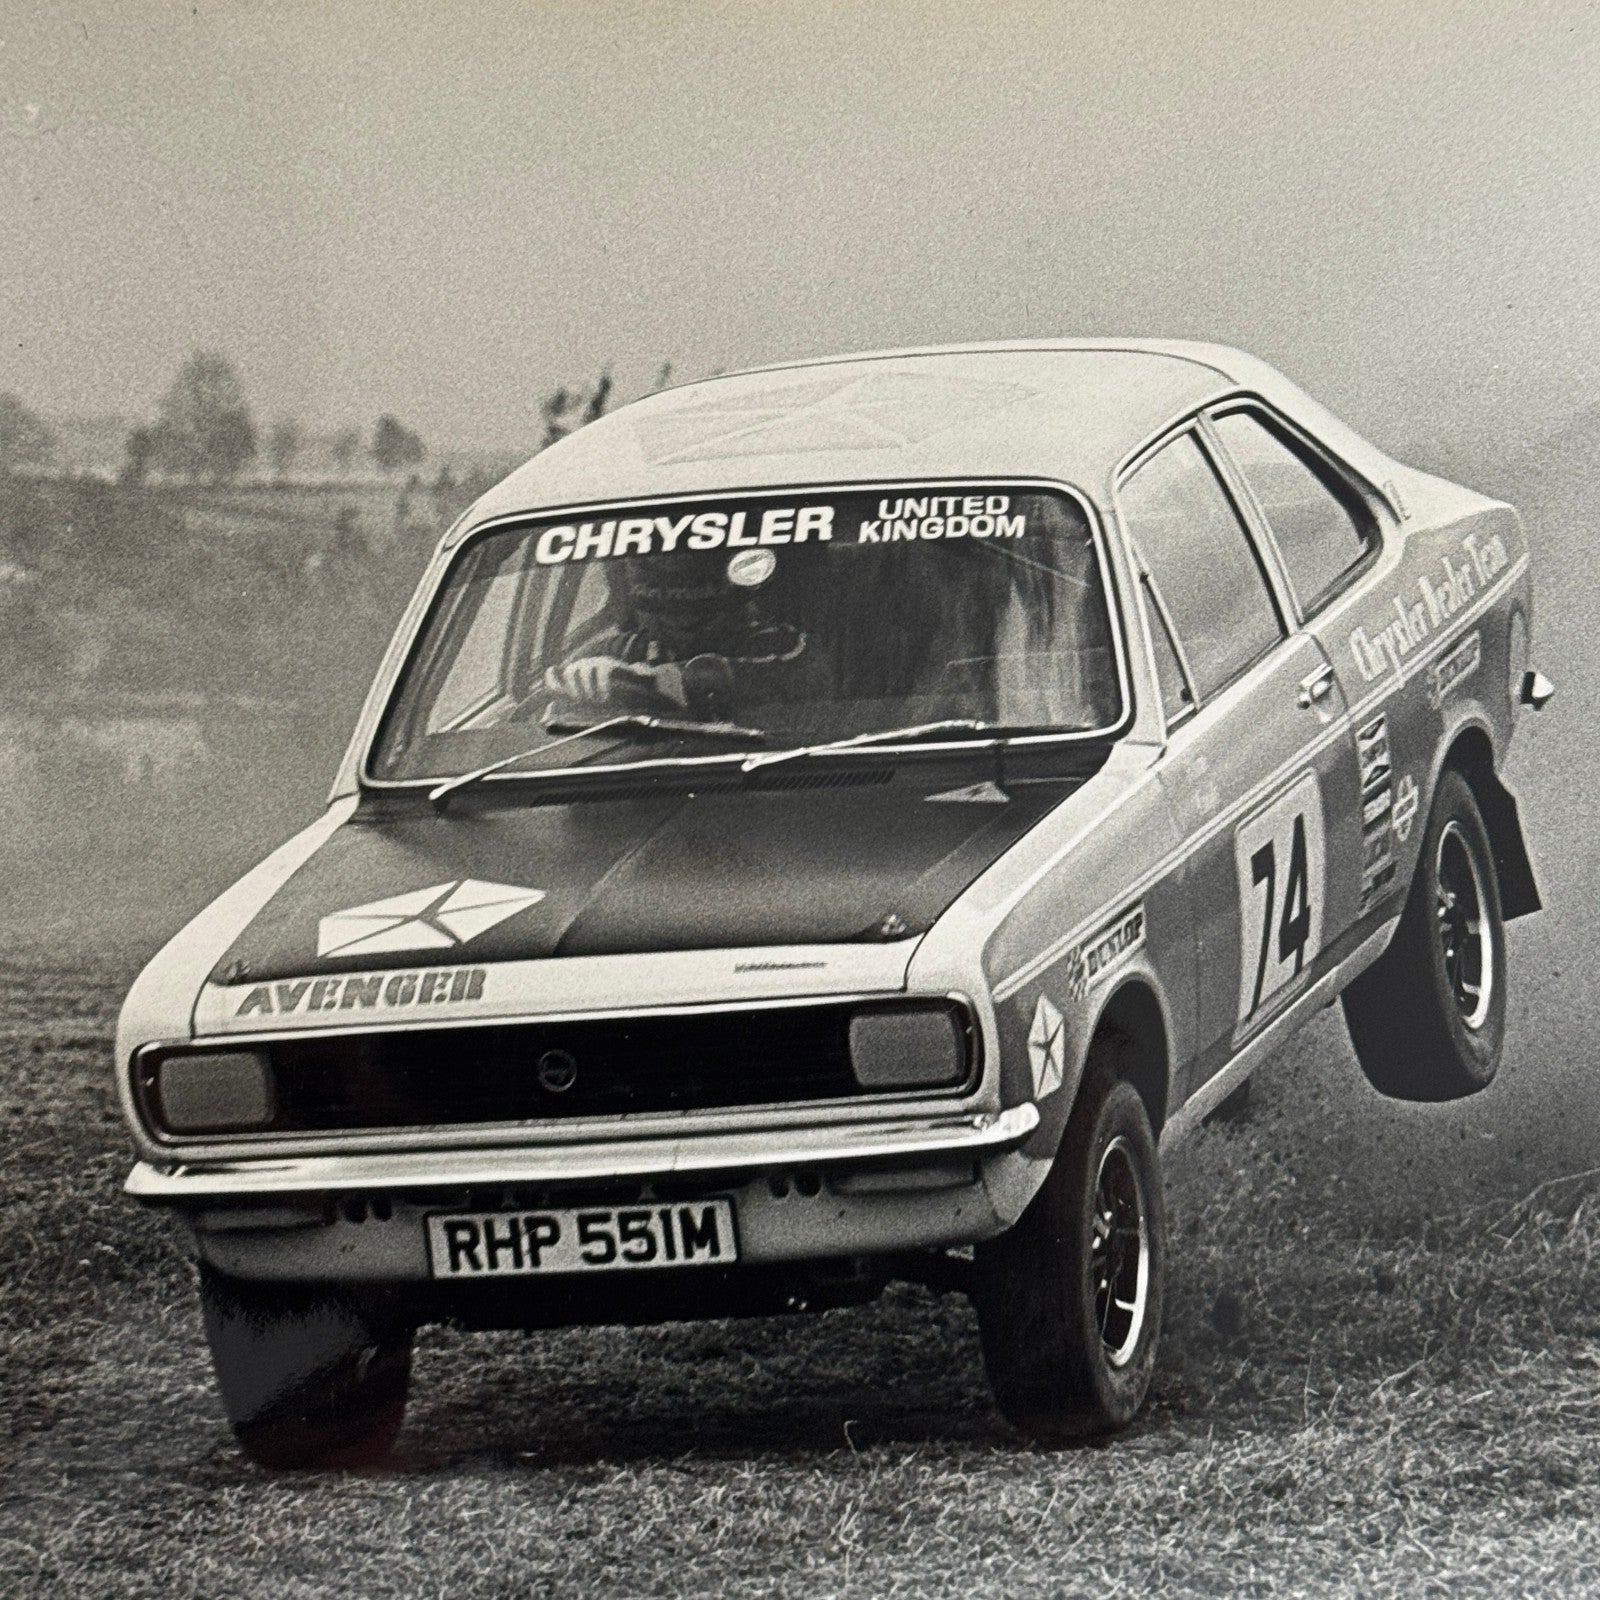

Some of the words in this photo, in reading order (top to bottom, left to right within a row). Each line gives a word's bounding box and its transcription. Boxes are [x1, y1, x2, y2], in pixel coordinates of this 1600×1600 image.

[535, 505, 835, 564] CHRYSLER
[857, 515, 1026, 544] KINGDOM
[878, 495, 1010, 521] UNITED
[1251, 811, 1311, 1024] 74
[234, 968, 487, 1017] AVENGER
[443, 1215, 561, 1273] RHP
[577, 1205, 721, 1265] 551M
